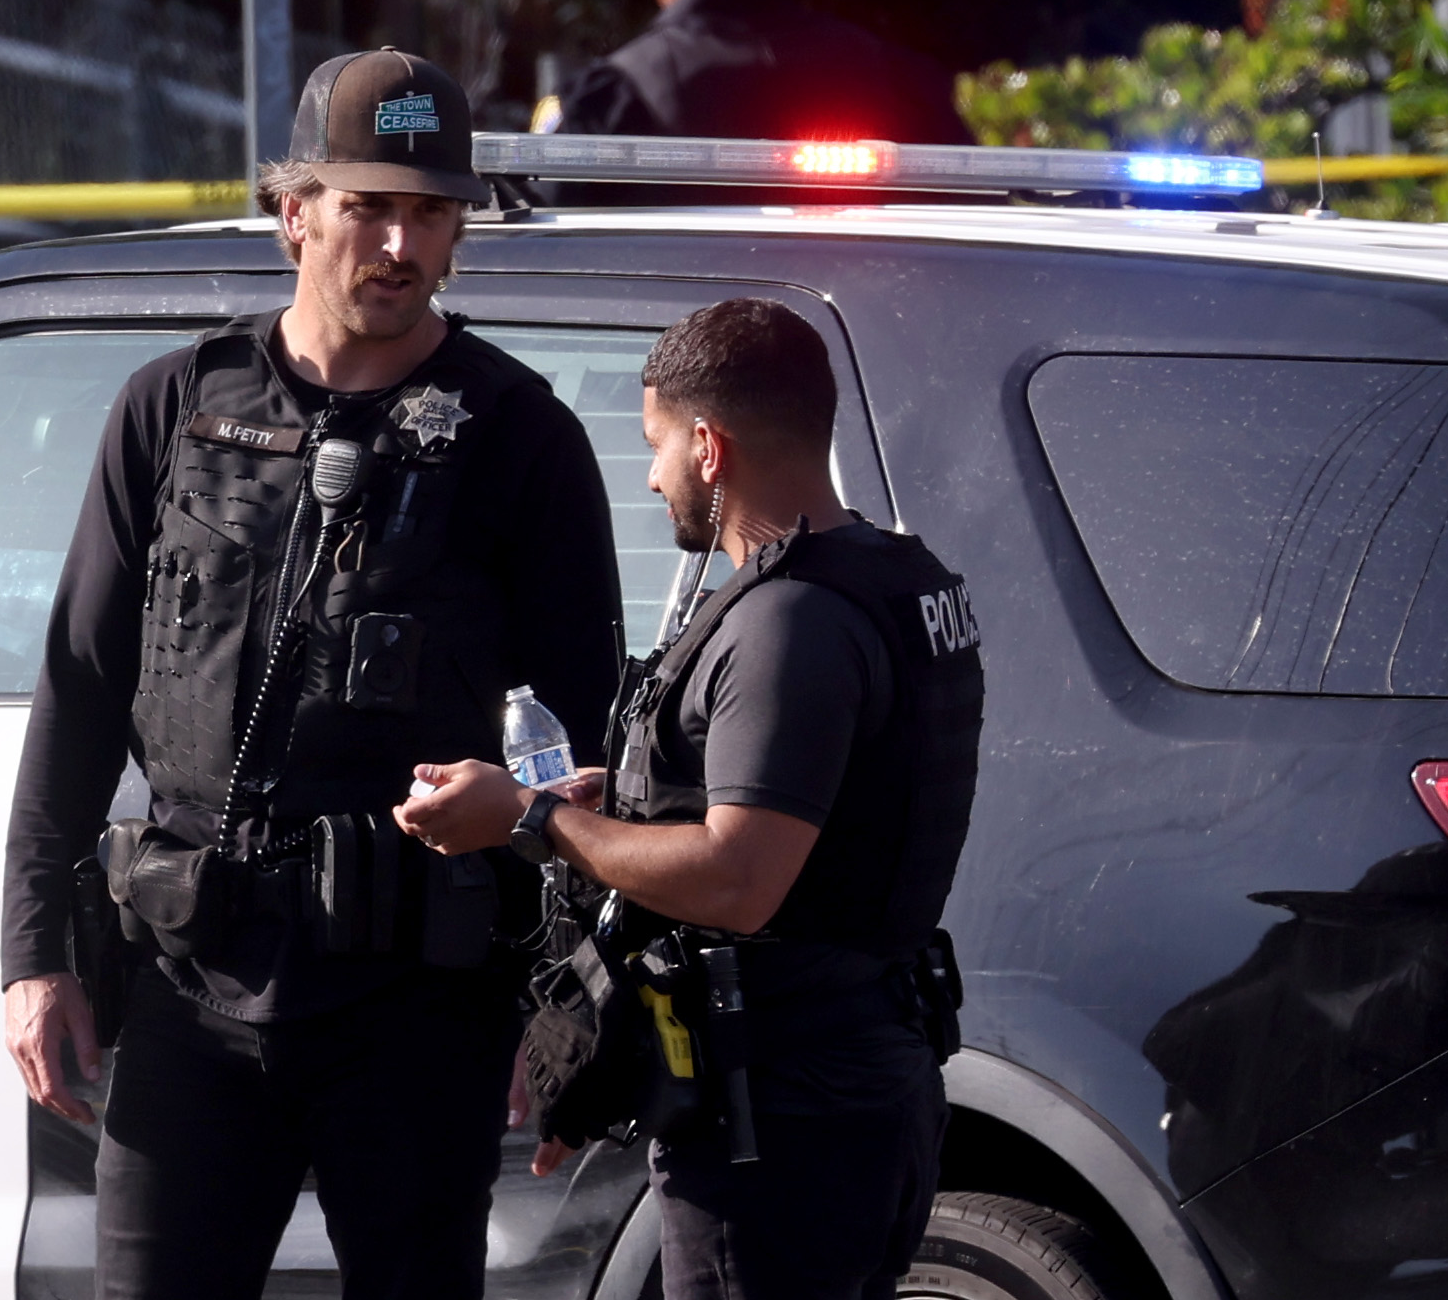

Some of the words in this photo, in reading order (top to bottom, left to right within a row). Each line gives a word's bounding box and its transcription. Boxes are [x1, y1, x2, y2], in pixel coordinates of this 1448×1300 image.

[386, 103, 401, 112] THE
[402, 98, 431, 110] TOWN
[380, 115, 436, 129] CEASEFIRE
[418, 400, 459, 416] POLICE
[233, 426, 275, 445] PETTY
